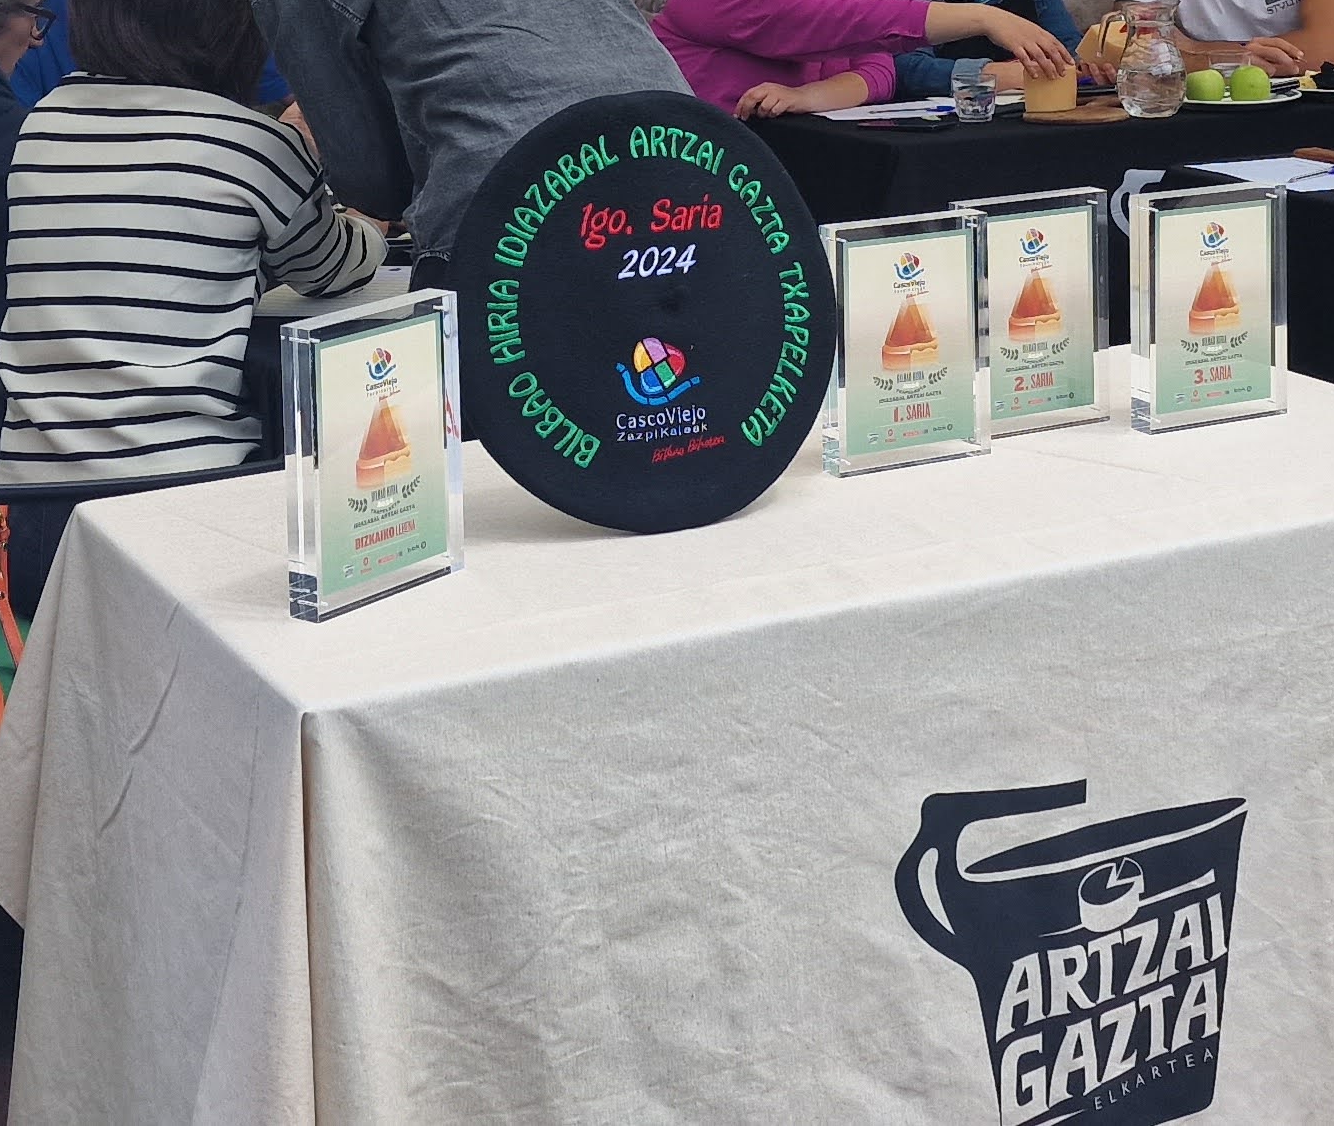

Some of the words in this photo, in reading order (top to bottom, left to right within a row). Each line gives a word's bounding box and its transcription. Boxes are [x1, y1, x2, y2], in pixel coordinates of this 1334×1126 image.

[628, 124, 726, 176] ARTZAI
[494, 133, 620, 268] IDIAZABAL
[650, 193, 723, 232] Saria
[728, 162, 790, 256] GAZTA
[617, 243, 697, 280] 2024
[485, 278, 526, 366] HIRIA
[740, 261, 810, 447] TXAPELKETA
[1013, 376, 1028, 392] 2.
[1031, 372, 1054, 389] SARIA
[1194, 369, 1208, 385] 3.
[1209, 365, 1232, 382] SARIA
[508, 371, 602, 469] BILBAO
[616, 404, 706, 430] CascoViejo
[893, 407, 904, 423] 1.
[906, 402, 931, 421] SARIA
[355, 526, 395, 551] BIZKAIKO
[995, 892, 1228, 1044] ARTZAI
[1000, 968, 1220, 1126] GAZTA
[1093, 1047, 1215, 1111] ELKARTEA
